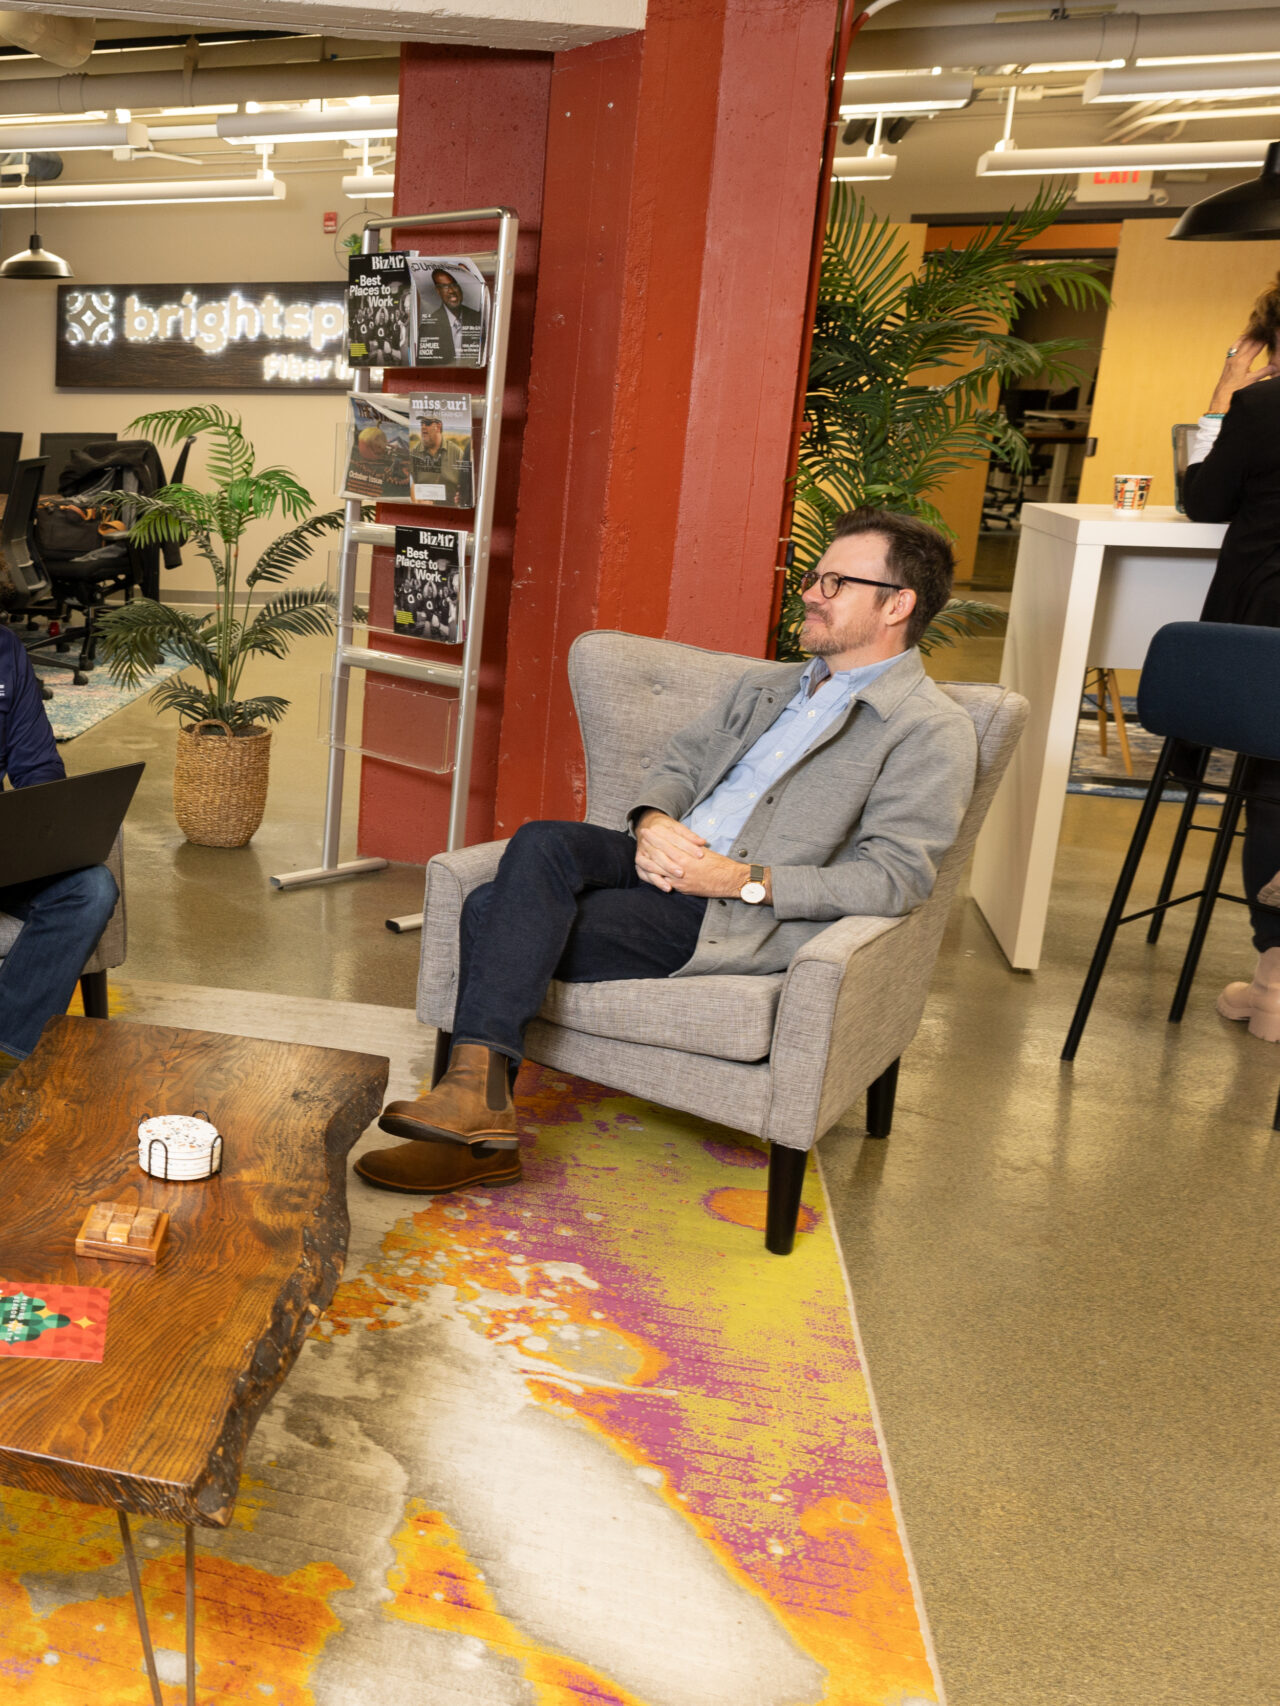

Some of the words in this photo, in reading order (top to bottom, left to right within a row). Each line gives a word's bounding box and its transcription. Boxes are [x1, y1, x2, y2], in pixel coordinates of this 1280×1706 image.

[360, 275, 381, 287] Best
[349, 285, 380, 297] Places
[381, 285, 391, 295] to
[368, 296, 394, 308] Work
[124, 291, 346, 354] brightsp
[411, 395, 467, 411] missouri
[406, 547, 429, 559] Best
[396, 554, 428, 569] Places
[428, 560, 439, 570] to
[415, 569, 442, 583] Work
